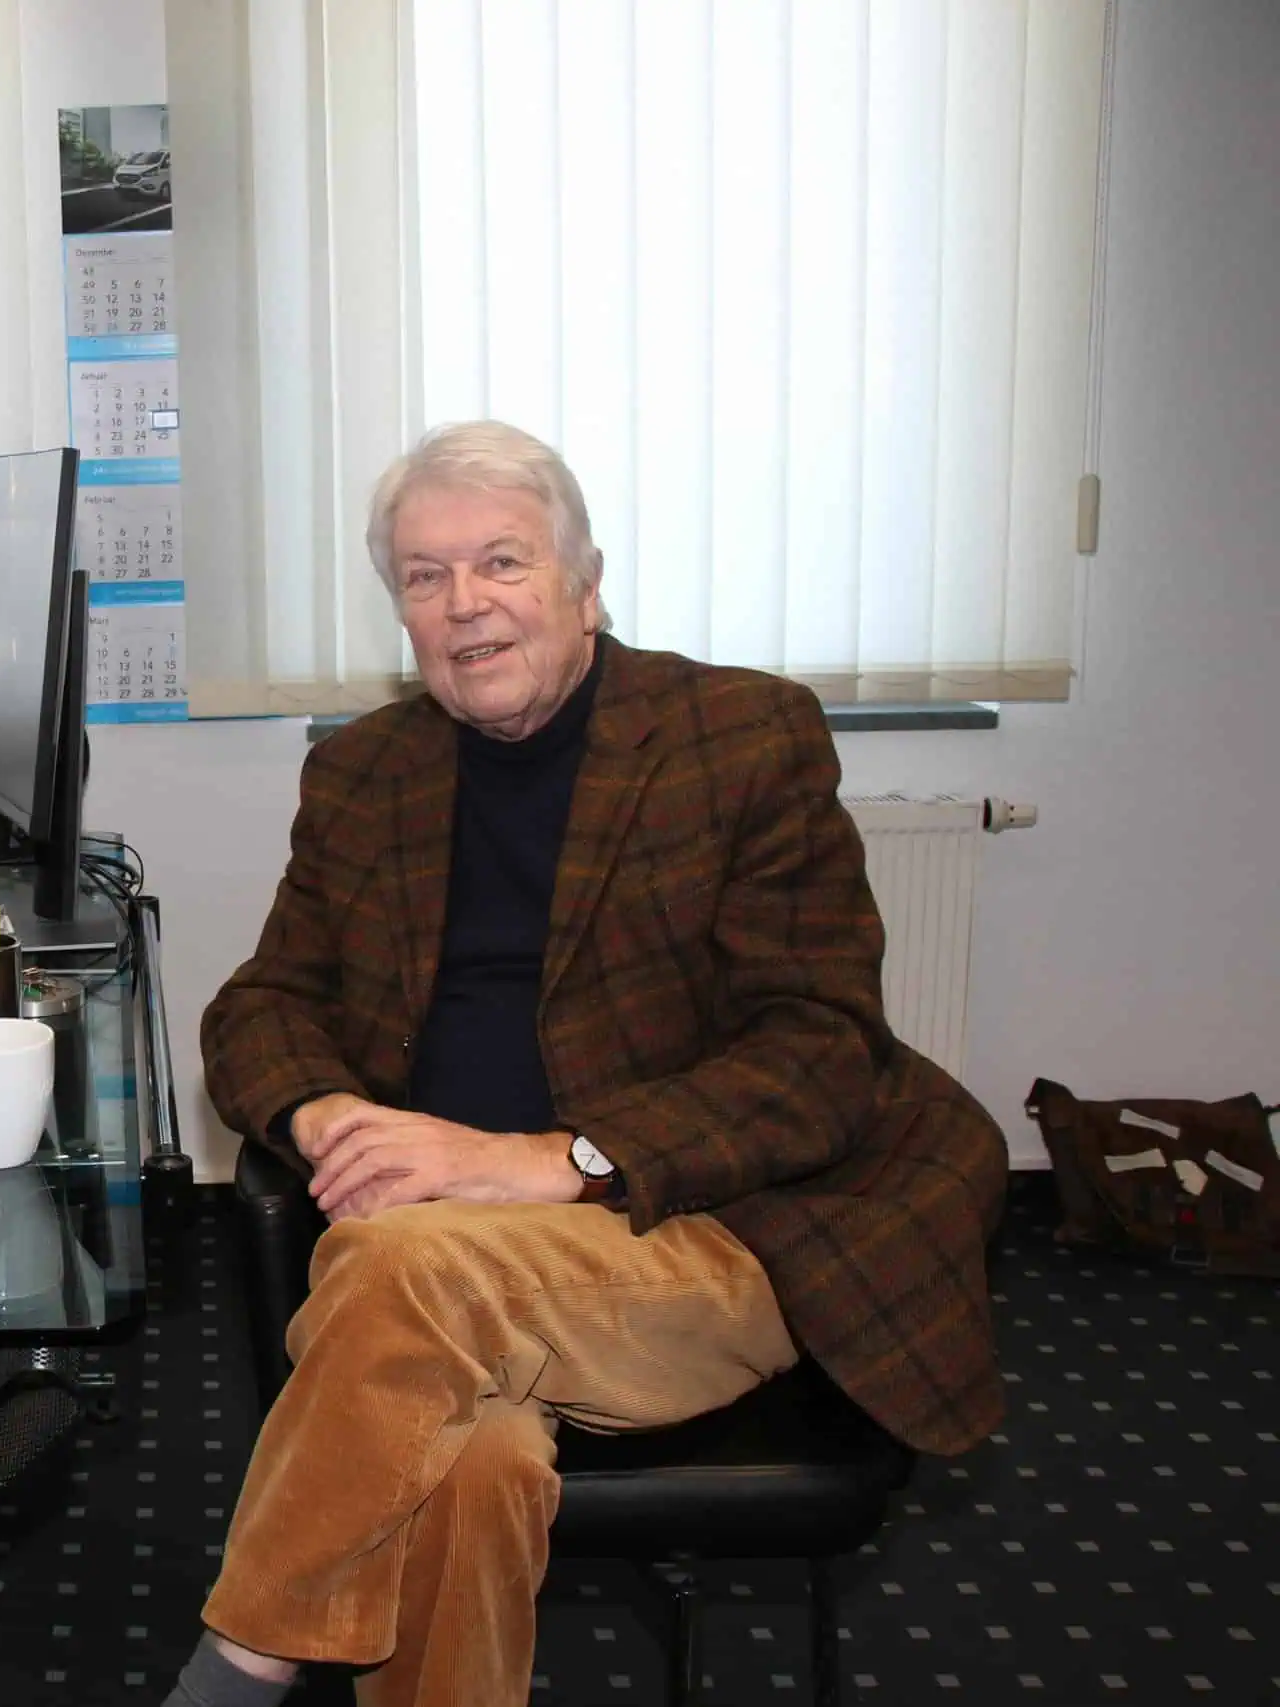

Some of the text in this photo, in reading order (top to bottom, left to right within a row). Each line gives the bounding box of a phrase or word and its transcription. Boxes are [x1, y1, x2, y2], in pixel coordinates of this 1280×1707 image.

[111, 280, 118, 290] 5
[134, 280, 141, 289] 6
[158, 278, 165, 288] 7
[106, 294, 118, 304] 12
[130, 294, 142, 304] 13
[152, 292, 166, 303] 14
[106, 308, 119, 318] 19
[129, 307, 142, 318] 20
[152, 306, 166, 317] 21
[129, 322, 142, 332] 27
[162, 388, 169, 397] 4
[134, 402, 146, 412] 10
[112, 418, 122, 427] 16
[111, 432, 122, 441] 23
[134, 430, 146, 440] 24
[120, 528, 126, 536] 6
[143, 526, 149, 536] 7
[166, 526, 172, 536] 8
[138, 540, 152, 551] 14
[161, 540, 173, 550] 15
[114, 554, 127, 564] 20
[138, 554, 149, 564] 21
[161, 553, 173, 564] 22
[116, 568, 128, 578] 27
[138, 568, 151, 578] 28
[164, 660, 176, 670] 15
[118, 676, 130, 685] 20
[164, 674, 176, 684] 22
[120, 688, 130, 698] 27
[142, 688, 154, 698] 28
[164, 688, 177, 698] 29
